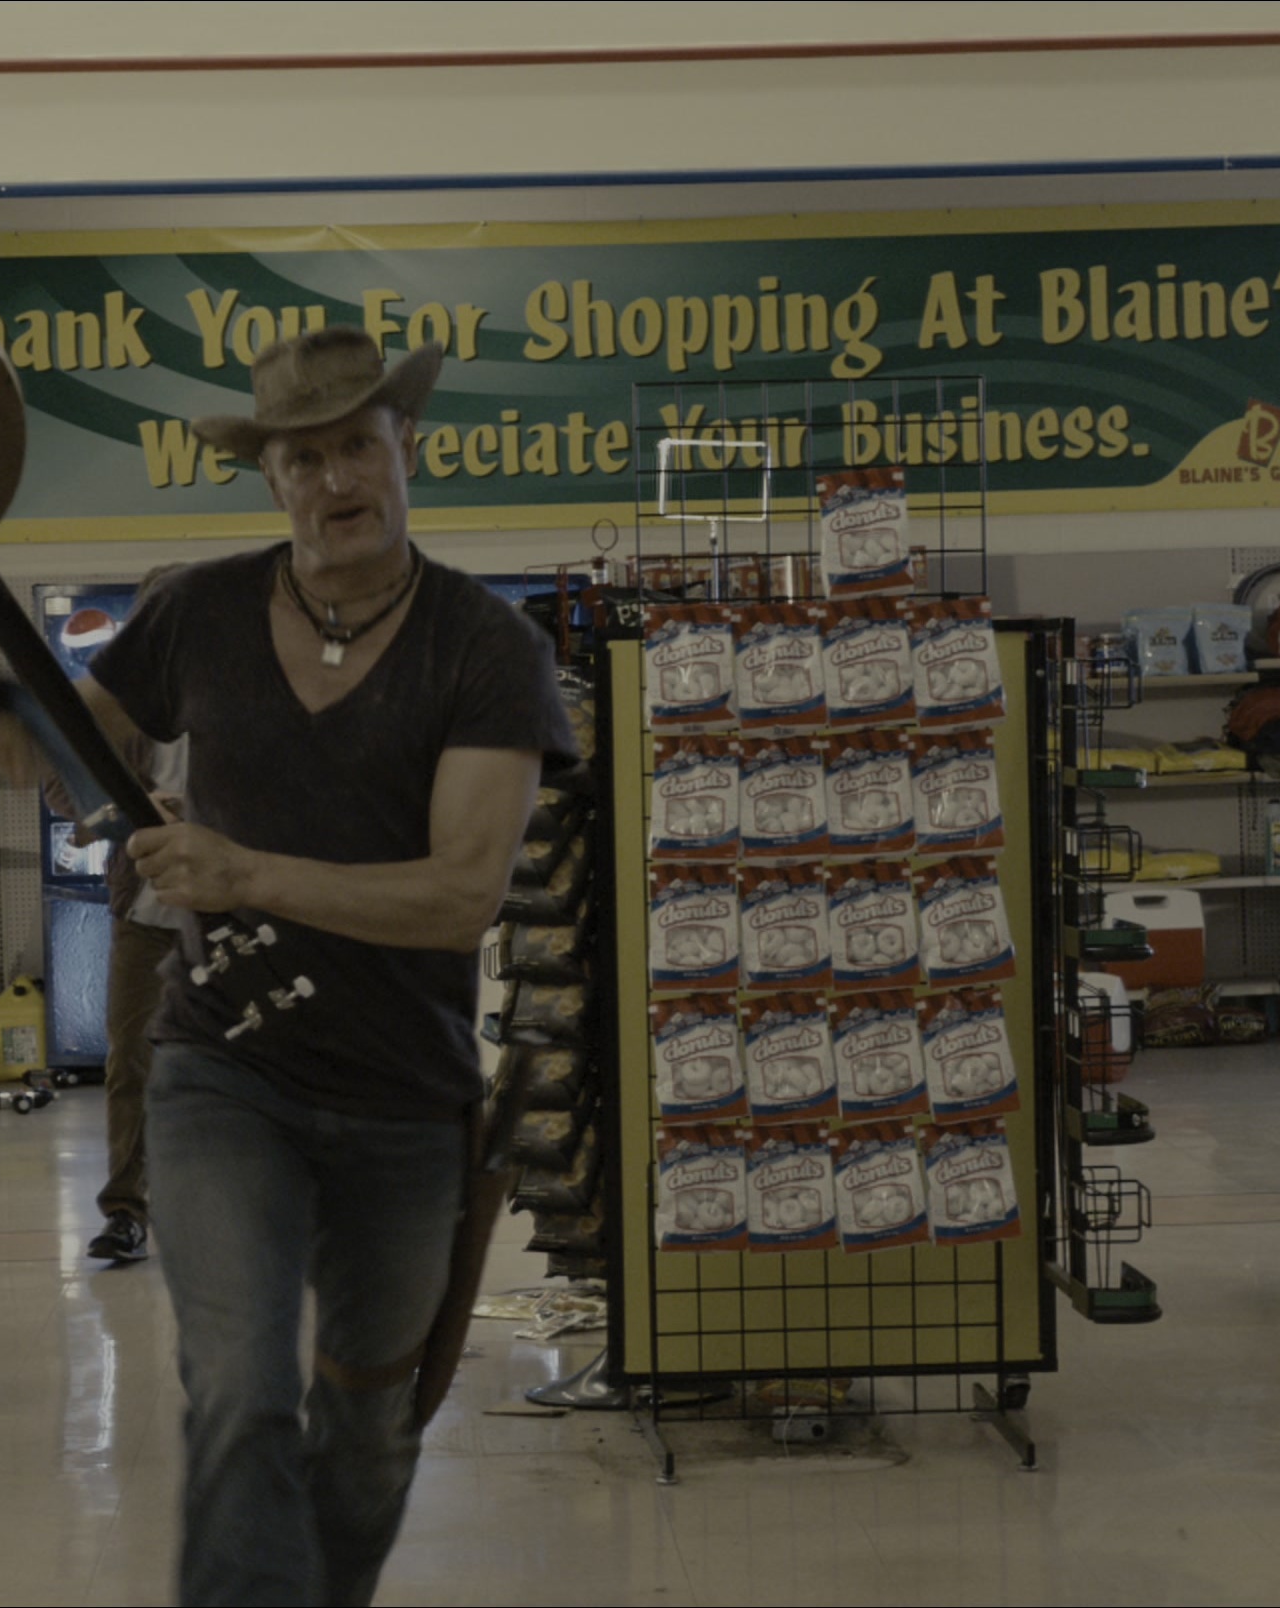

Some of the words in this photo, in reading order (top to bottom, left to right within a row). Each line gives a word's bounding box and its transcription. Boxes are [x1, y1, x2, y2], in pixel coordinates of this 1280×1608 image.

[186, 286, 329, 369] You
[362, 288, 489, 362] For
[523, 275, 884, 380] Shopping
[919, 269, 1008, 351] At
[138, 418, 238, 488] We
[414, 409, 632, 478] eciate
[658, 401, 811, 473] Your
[841, 395, 1151, 467] Business.
[1178, 466, 1261, 485] BLAINE'S
